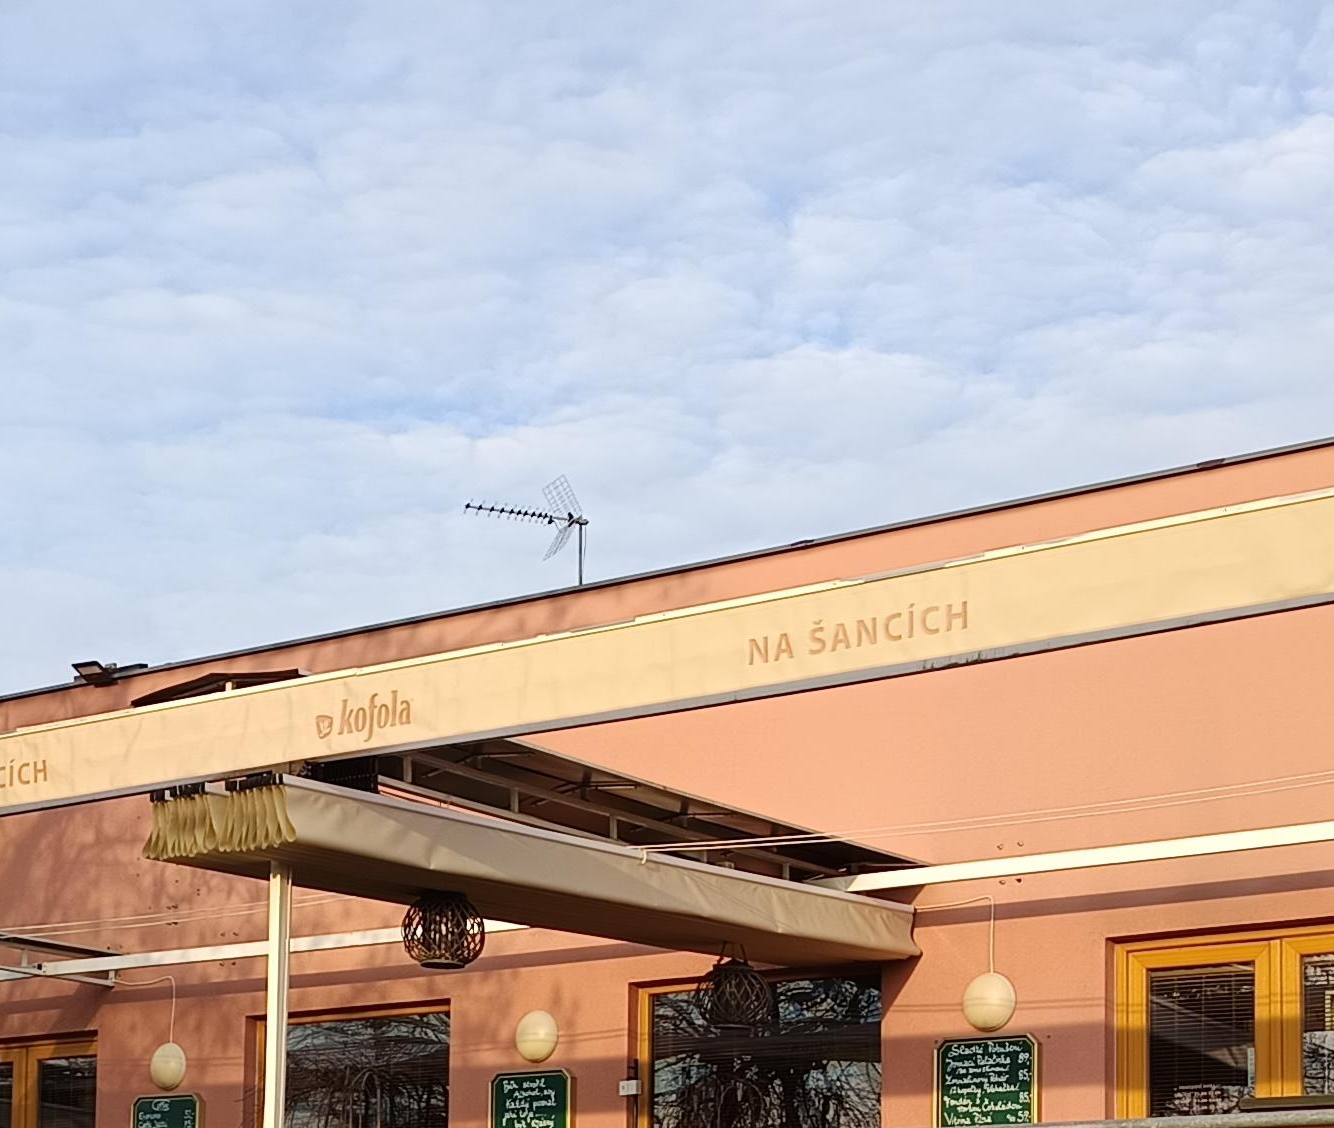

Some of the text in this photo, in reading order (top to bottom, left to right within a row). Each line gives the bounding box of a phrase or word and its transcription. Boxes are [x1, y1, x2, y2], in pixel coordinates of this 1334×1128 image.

[748, 600, 968, 666] NA ŠANCÍCH
[337, 689, 412, 743] kofola
